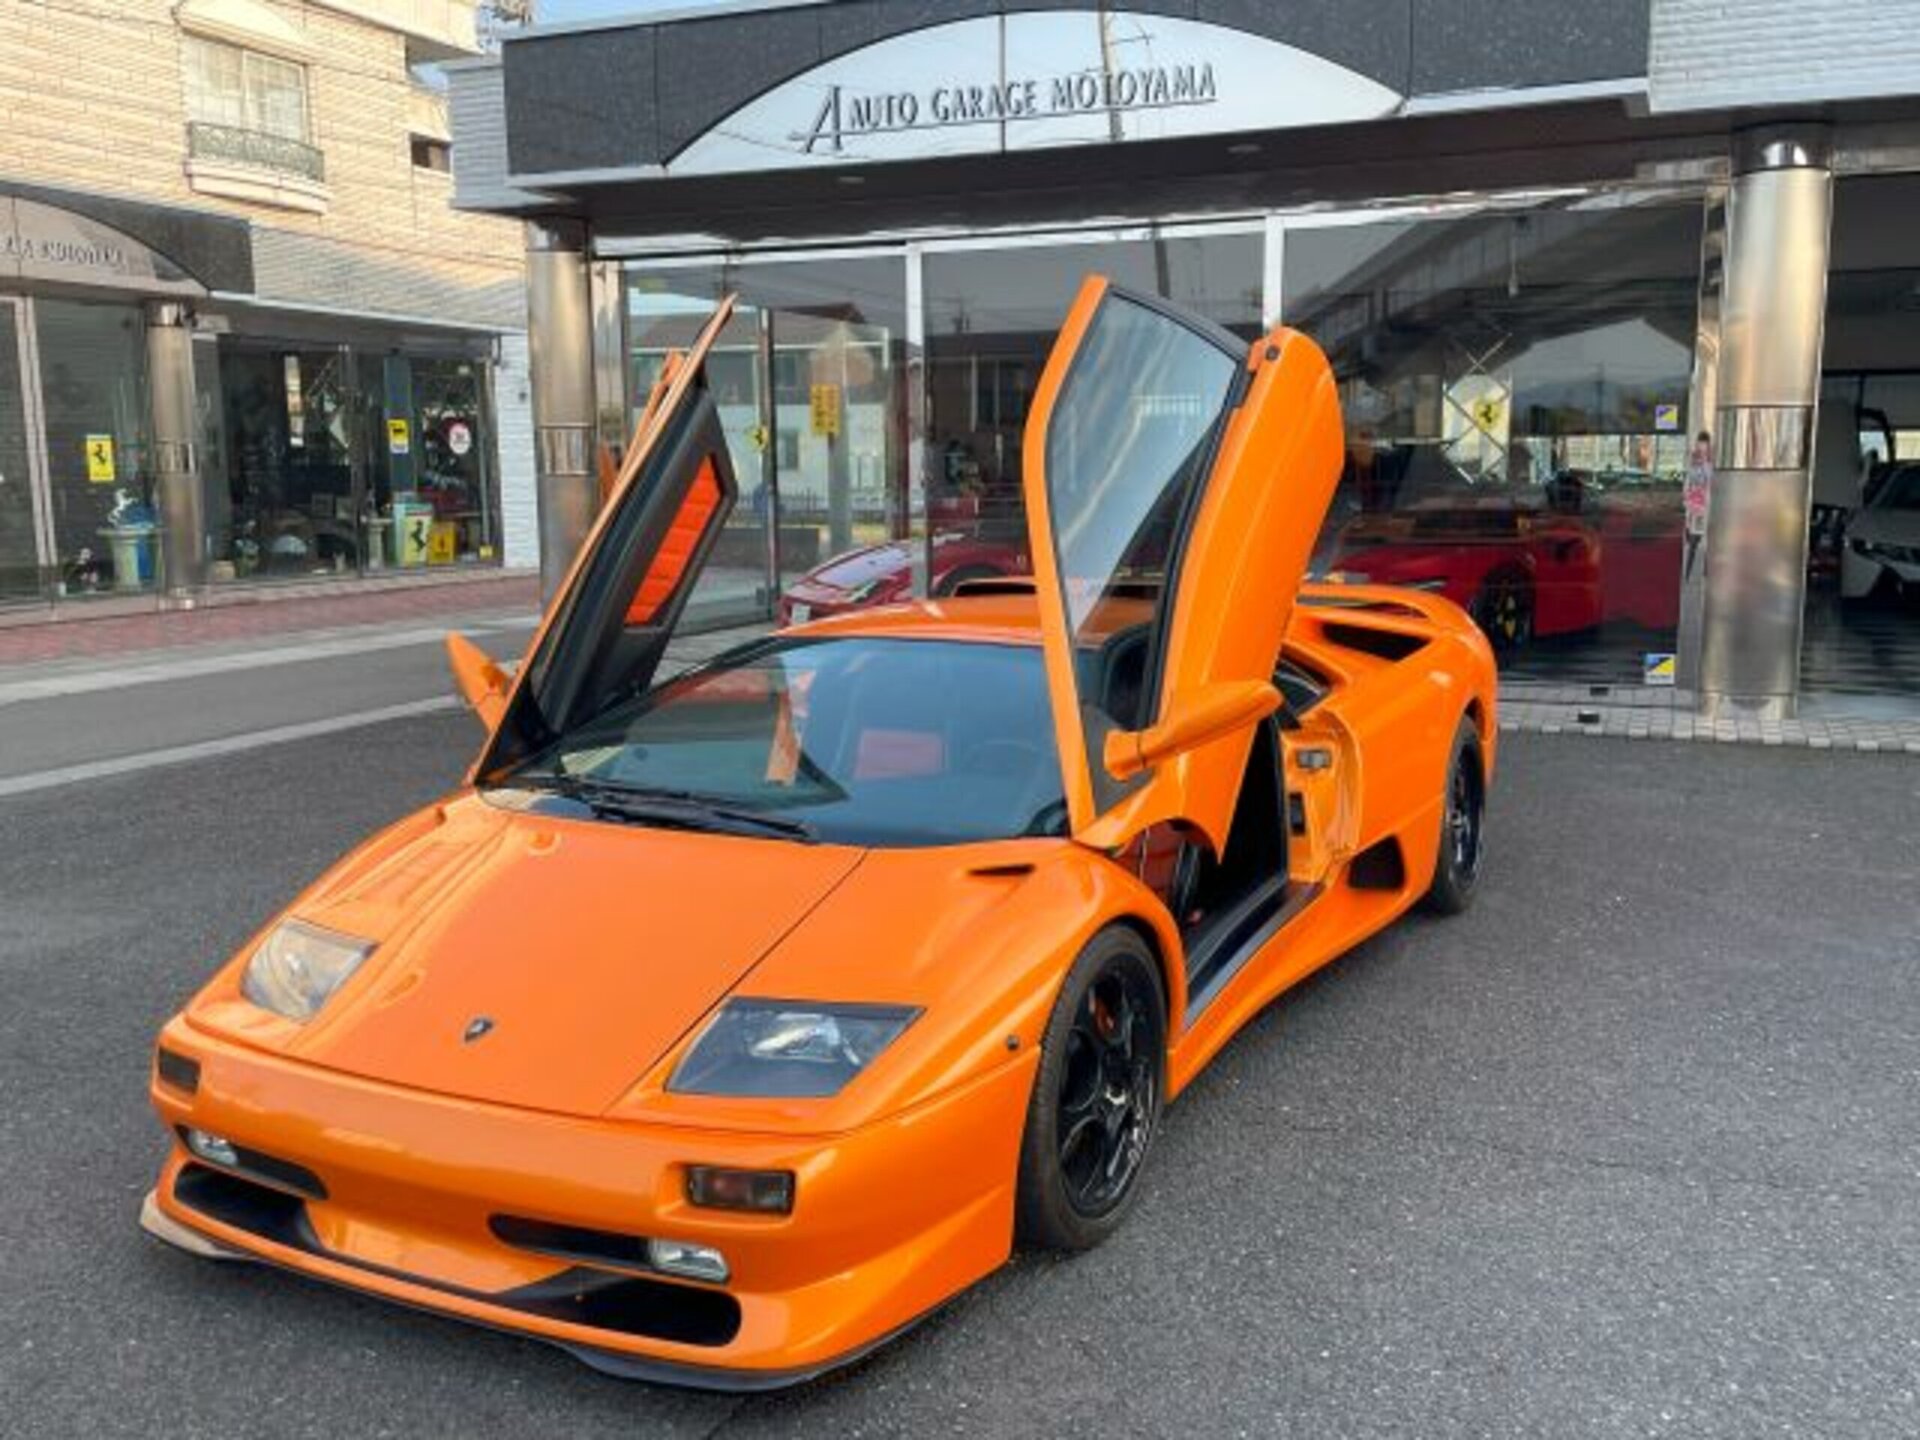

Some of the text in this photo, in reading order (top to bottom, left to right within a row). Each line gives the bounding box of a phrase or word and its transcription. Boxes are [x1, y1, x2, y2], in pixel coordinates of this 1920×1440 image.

[791, 63, 1216, 153] AUTO GARAGE MOTOYAMA
